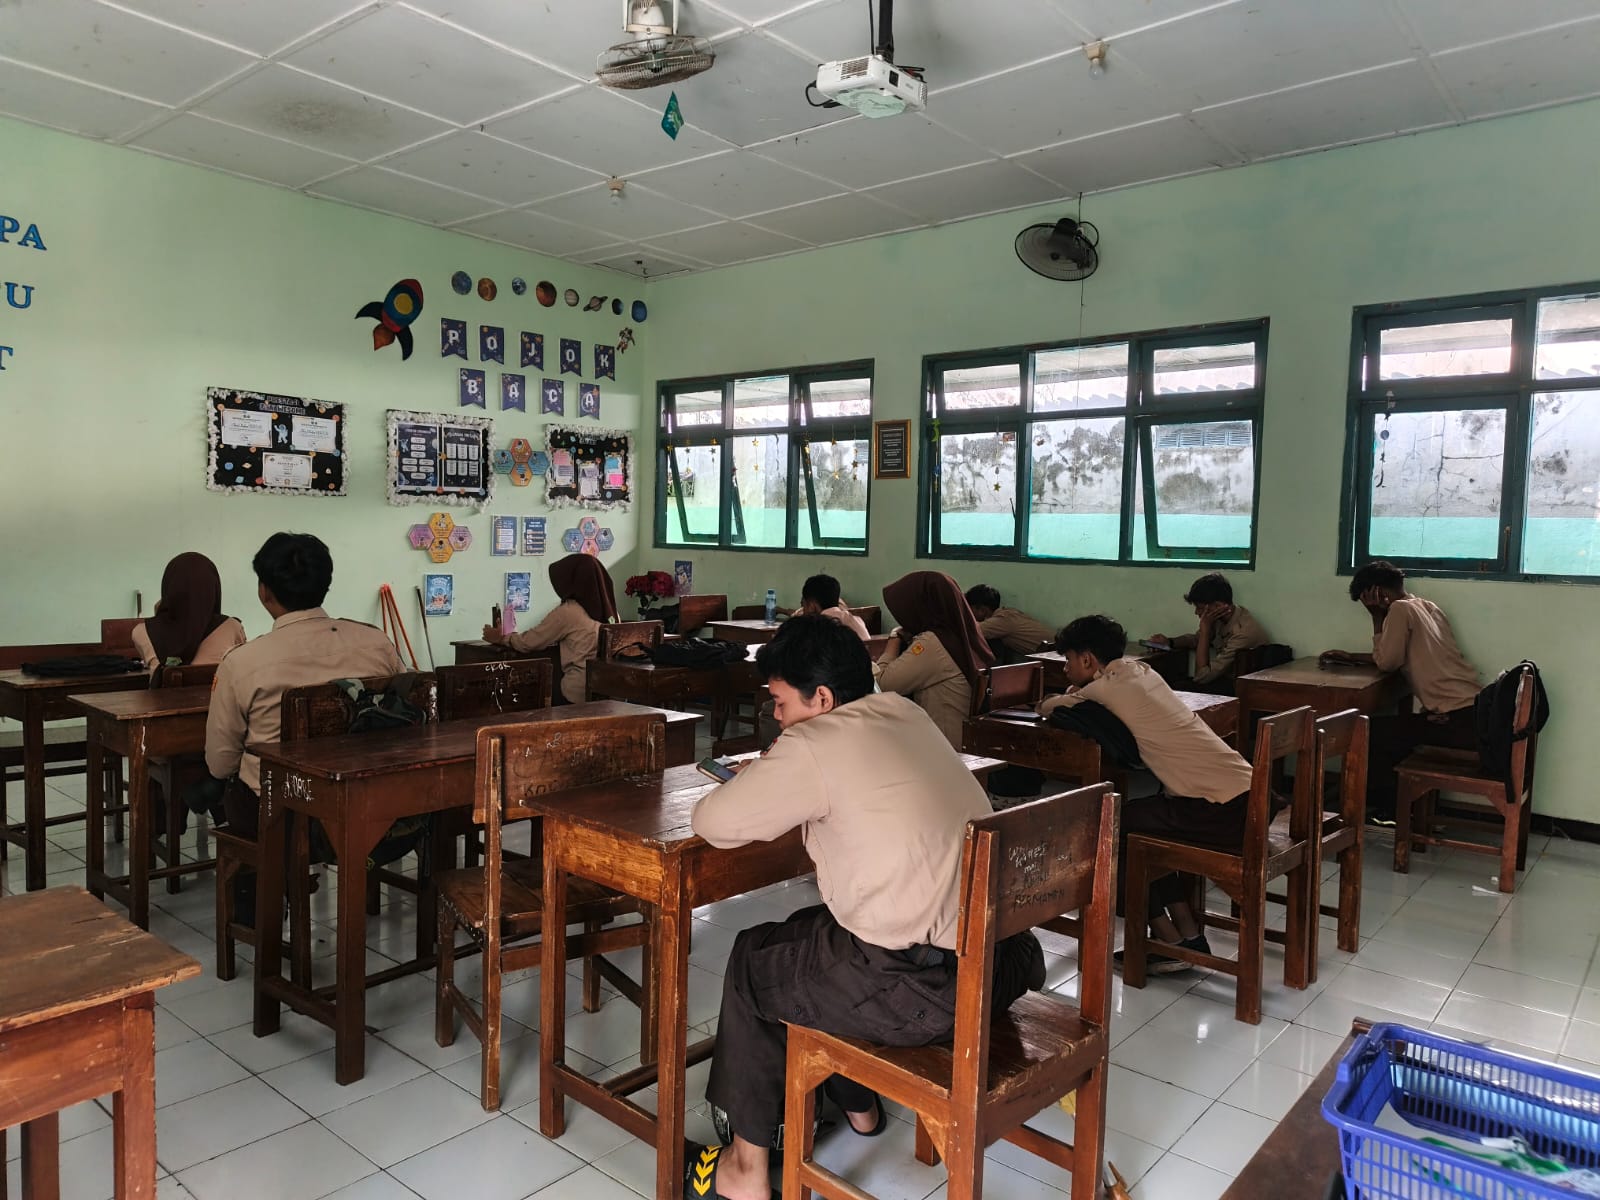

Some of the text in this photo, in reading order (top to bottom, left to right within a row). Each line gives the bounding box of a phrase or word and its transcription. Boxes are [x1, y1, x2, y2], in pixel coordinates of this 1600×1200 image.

[0, 215, 47, 251] PA
[448, 330, 609, 368] POJOK
[467, 379, 594, 409] BACA
